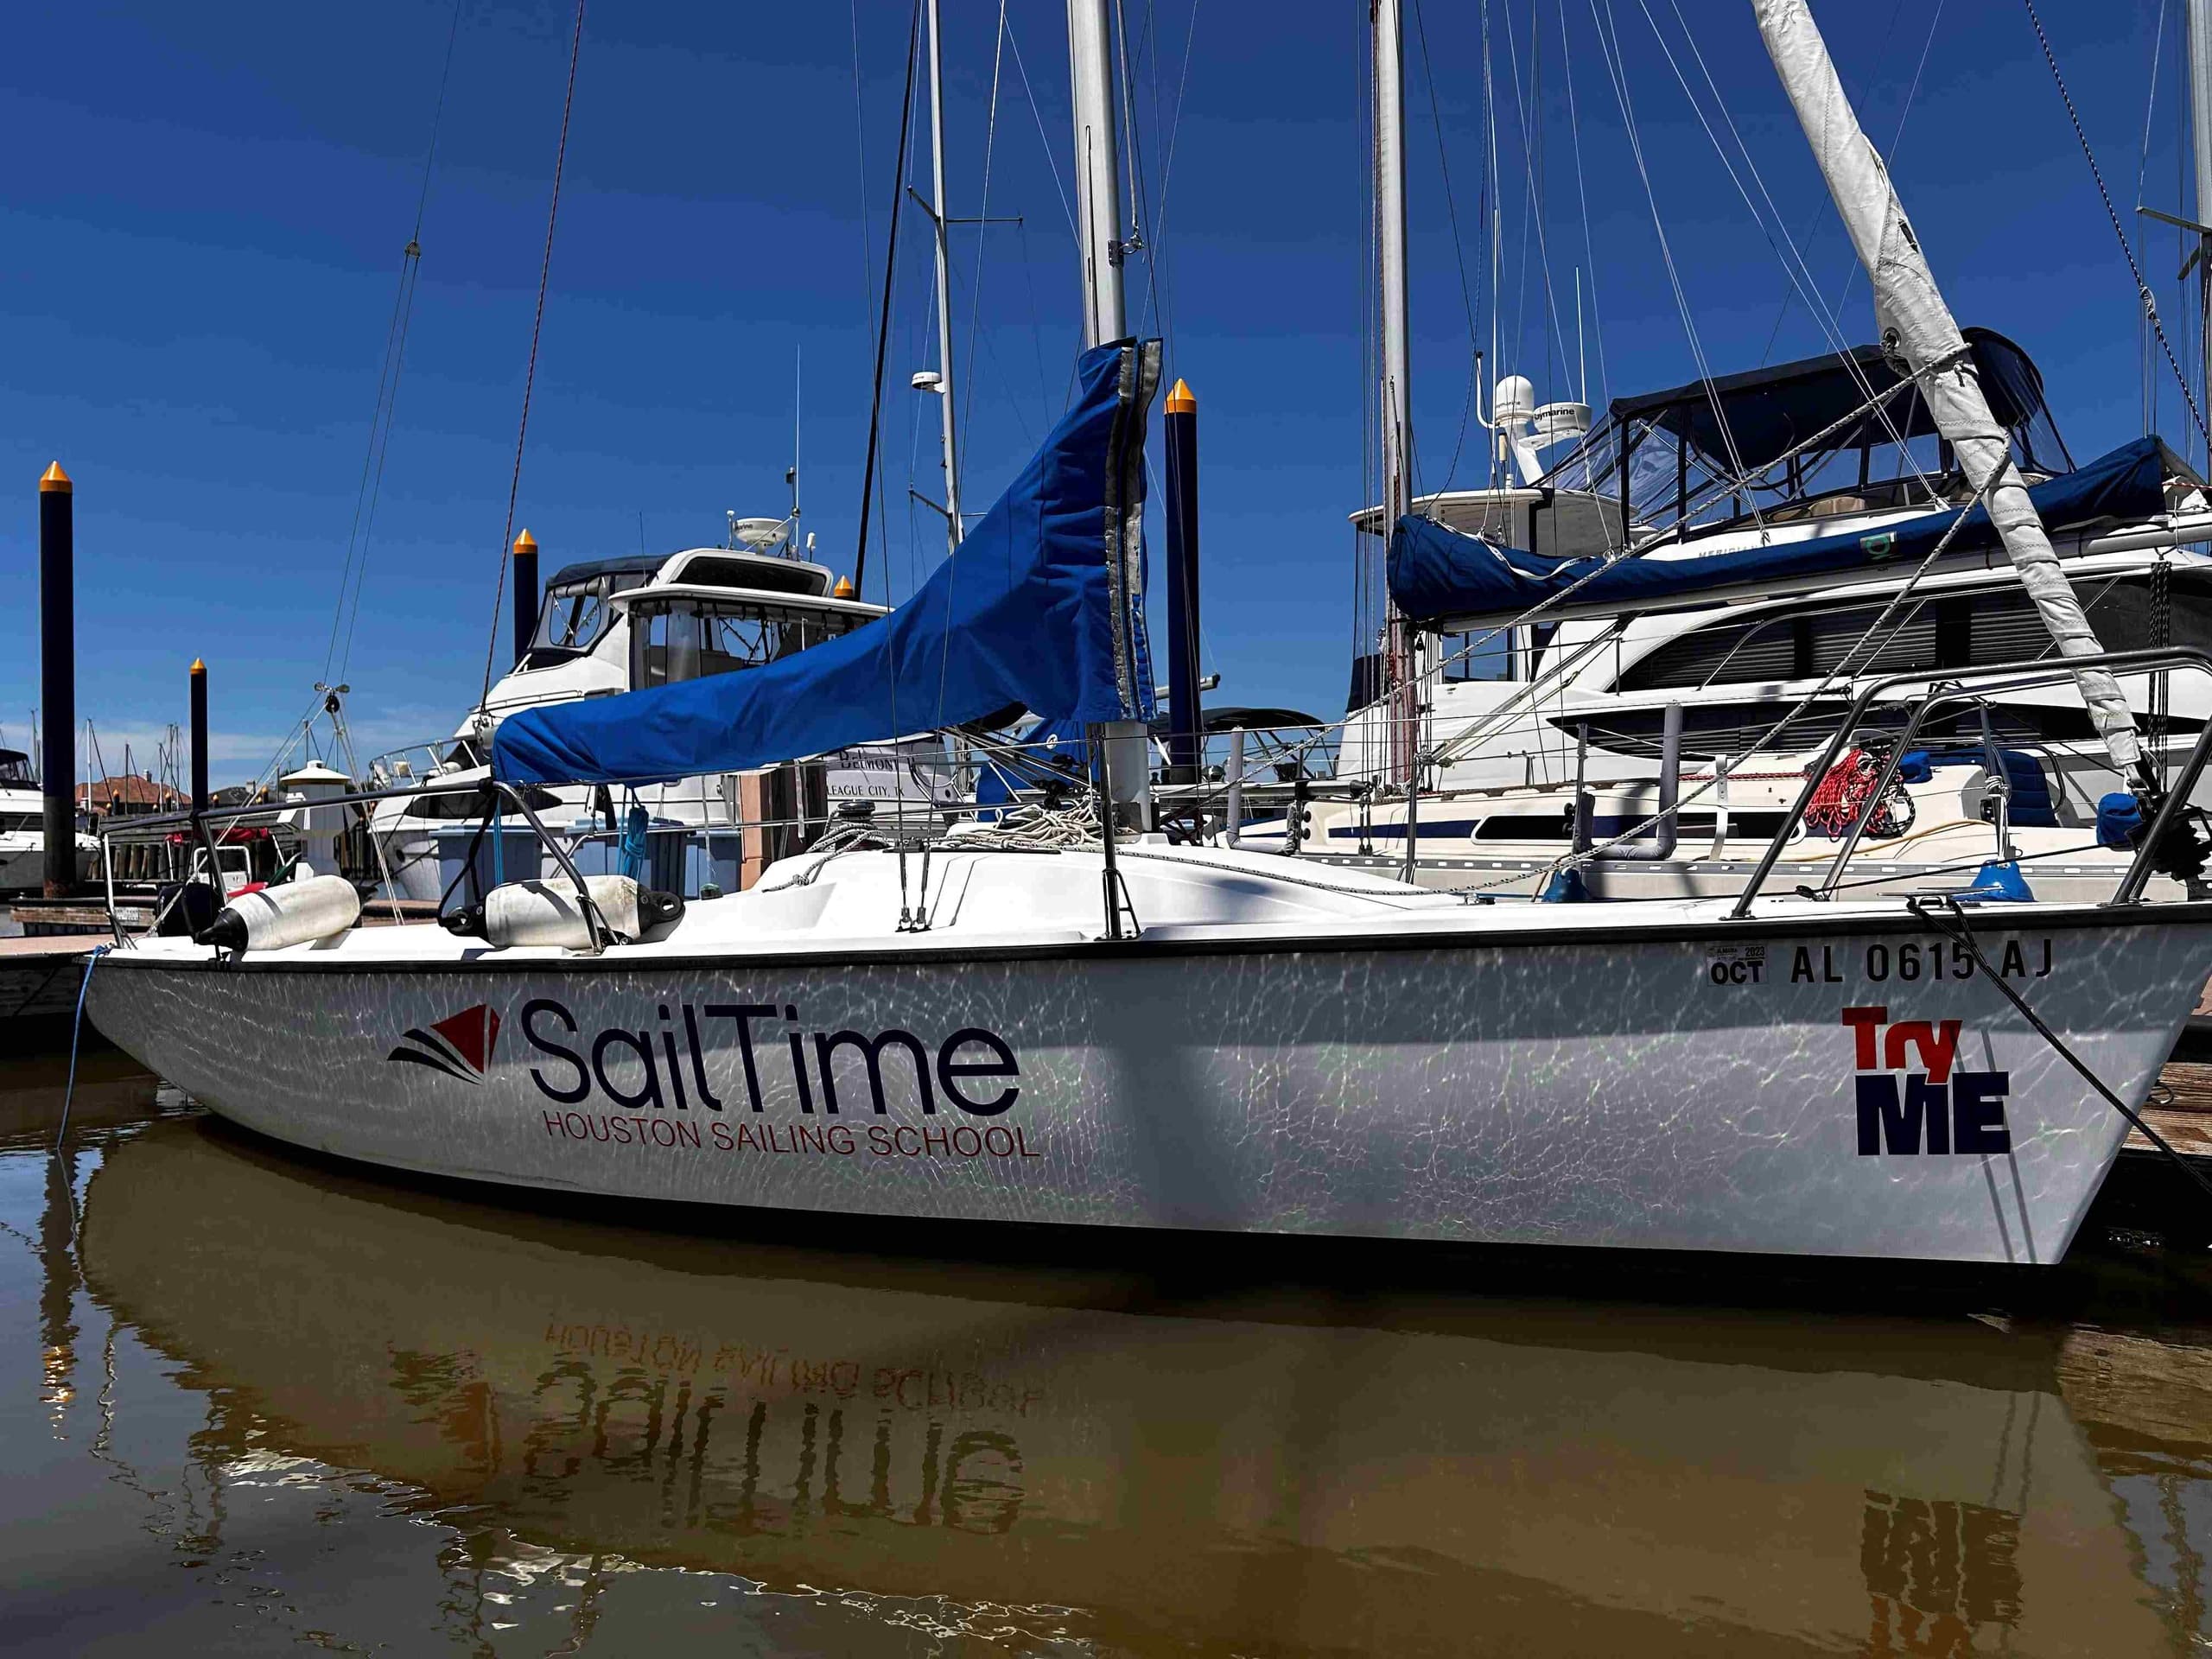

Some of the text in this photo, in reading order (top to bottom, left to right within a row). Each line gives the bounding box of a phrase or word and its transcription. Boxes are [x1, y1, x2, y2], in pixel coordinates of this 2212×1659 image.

[1711, 960, 1764, 984] OCT
[1790, 938, 2052, 983] AL 0615 AJ
[520, 999, 1020, 1117] SailTime
[1841, 1007, 1963, 1084] Try
[543, 1109, 1041, 1157] HOUSTON SAILING SCHOOL
[1854, 1071, 2012, 1157] ME
